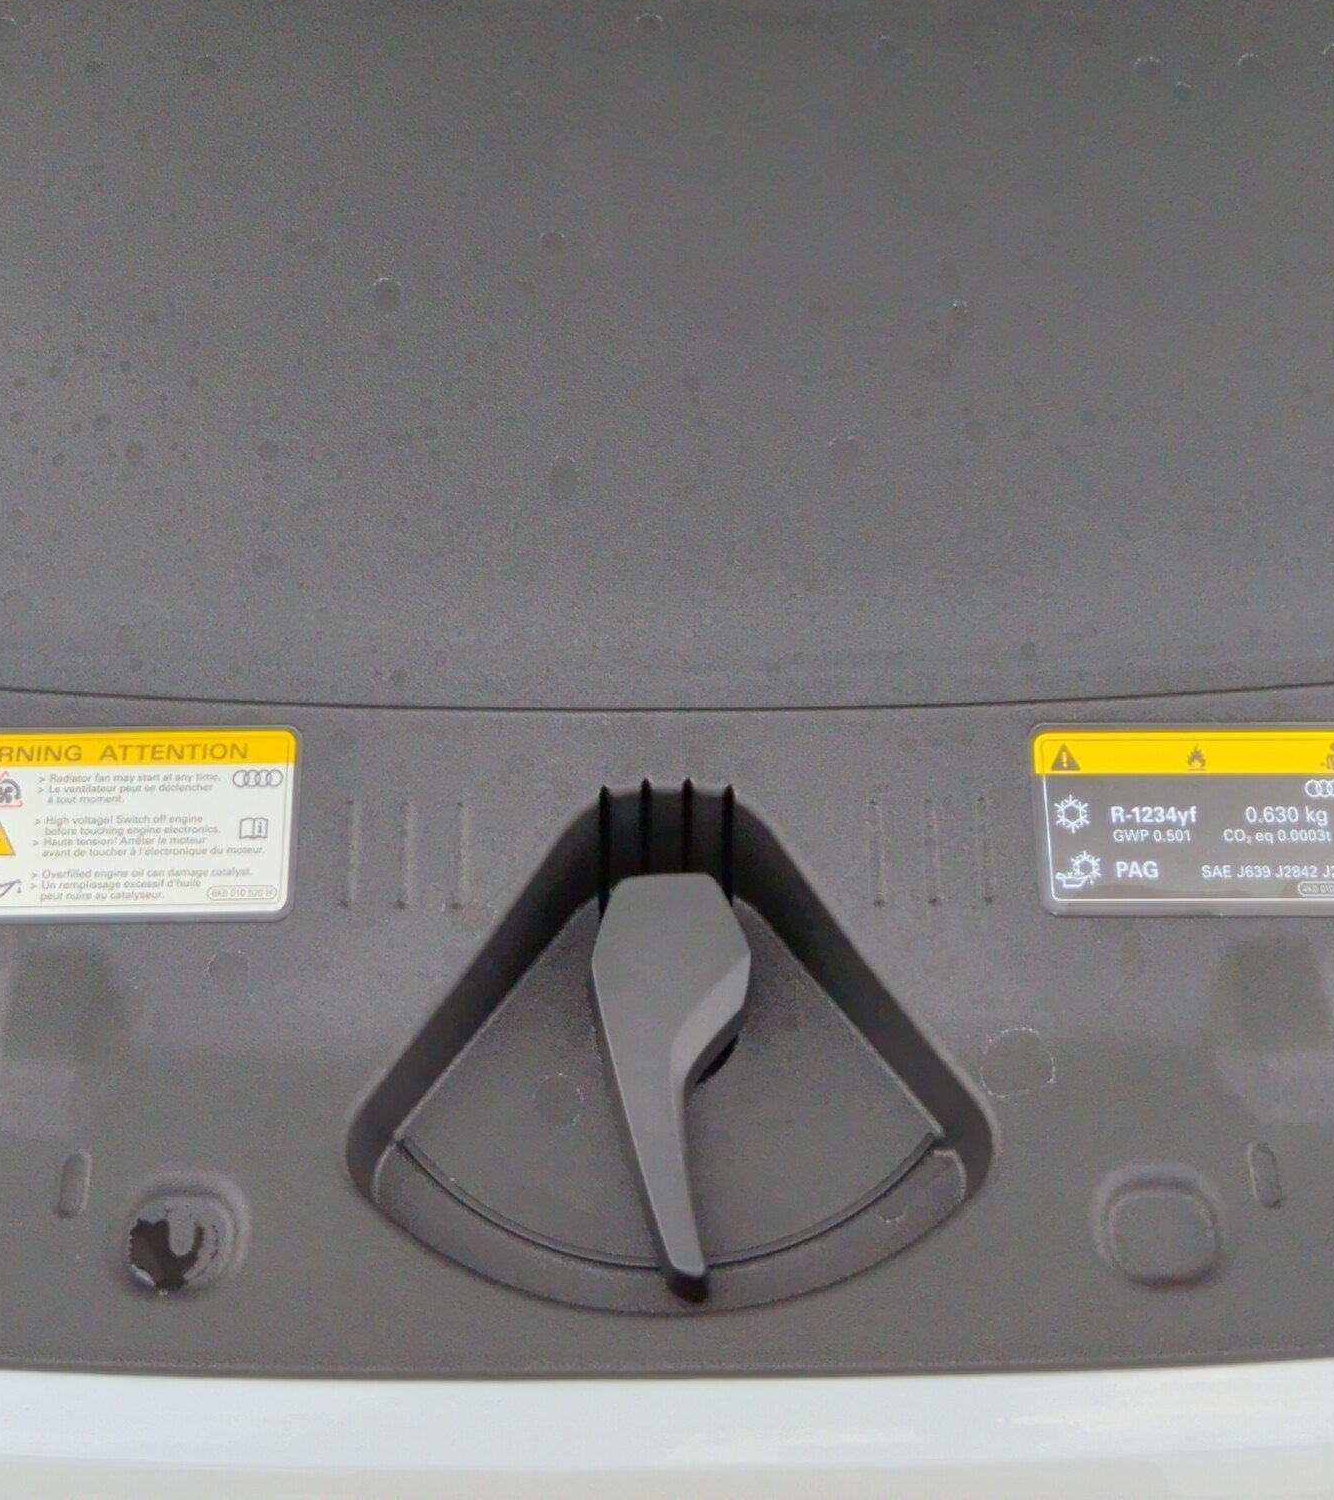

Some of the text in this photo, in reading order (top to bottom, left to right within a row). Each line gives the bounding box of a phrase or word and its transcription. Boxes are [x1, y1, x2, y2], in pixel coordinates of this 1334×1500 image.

[98, 742, 249, 761] ATTENTION
[49, 774, 92, 784] Radiator
[94, 773, 111, 783] fan
[114, 775, 135, 785] may
[137, 773, 161, 783] start
[163, 774, 174, 782] at
[175, 774, 194, 784] any
[49, 784, 60, 793] Le
[64, 784, 117, 793] ventilateur
[119, 784, 142, 794] peut
[56, 795, 77, 804] tout
[46, 816, 69, 827] High
[116, 815, 151, 824] Switch
[153, 814, 167, 824] off
[169, 816, 203, 826] engine
[1110, 806, 1197, 827] R-1234yf
[1245, 806, 1329, 827] 0.630 kg
[45, 826, 77, 836] before
[79, 826, 124, 838] touching
[127, 826, 162, 837] engine
[1113, 829, 1191, 843] GWP 0.501
[1255, 831, 1274, 844] eq
[1277, 829, 1332, 843] 0.0003t
[43, 837, 73, 847] Haute
[158, 836, 167, 844] le
[169, 836, 206, 845] moteur
[42, 848, 70, 857] avant
[73, 847, 85, 857] de
[87, 847, 127, 857] toucher
[210, 846, 223, 855] du
[42, 869, 91, 879] Overfilled
[94, 870, 129, 881] engine
[131, 868, 144, 878] oil
[146, 869, 165, 878] can
[167, 867, 209, 879] damage
[1115, 861, 1159, 879] PAG
[1201, 865, 1232, 879] SAE
[1236, 865, 1271, 879] J639
[1275, 865, 1318, 879] J2842
[41, 880, 56, 889] Un
[59, 879, 120, 891] remplissage
[123, 879, 164, 888] excessif
[40, 891, 63, 902] peut
[66, 890, 92, 900] nuire
[95, 891, 108, 900] au
